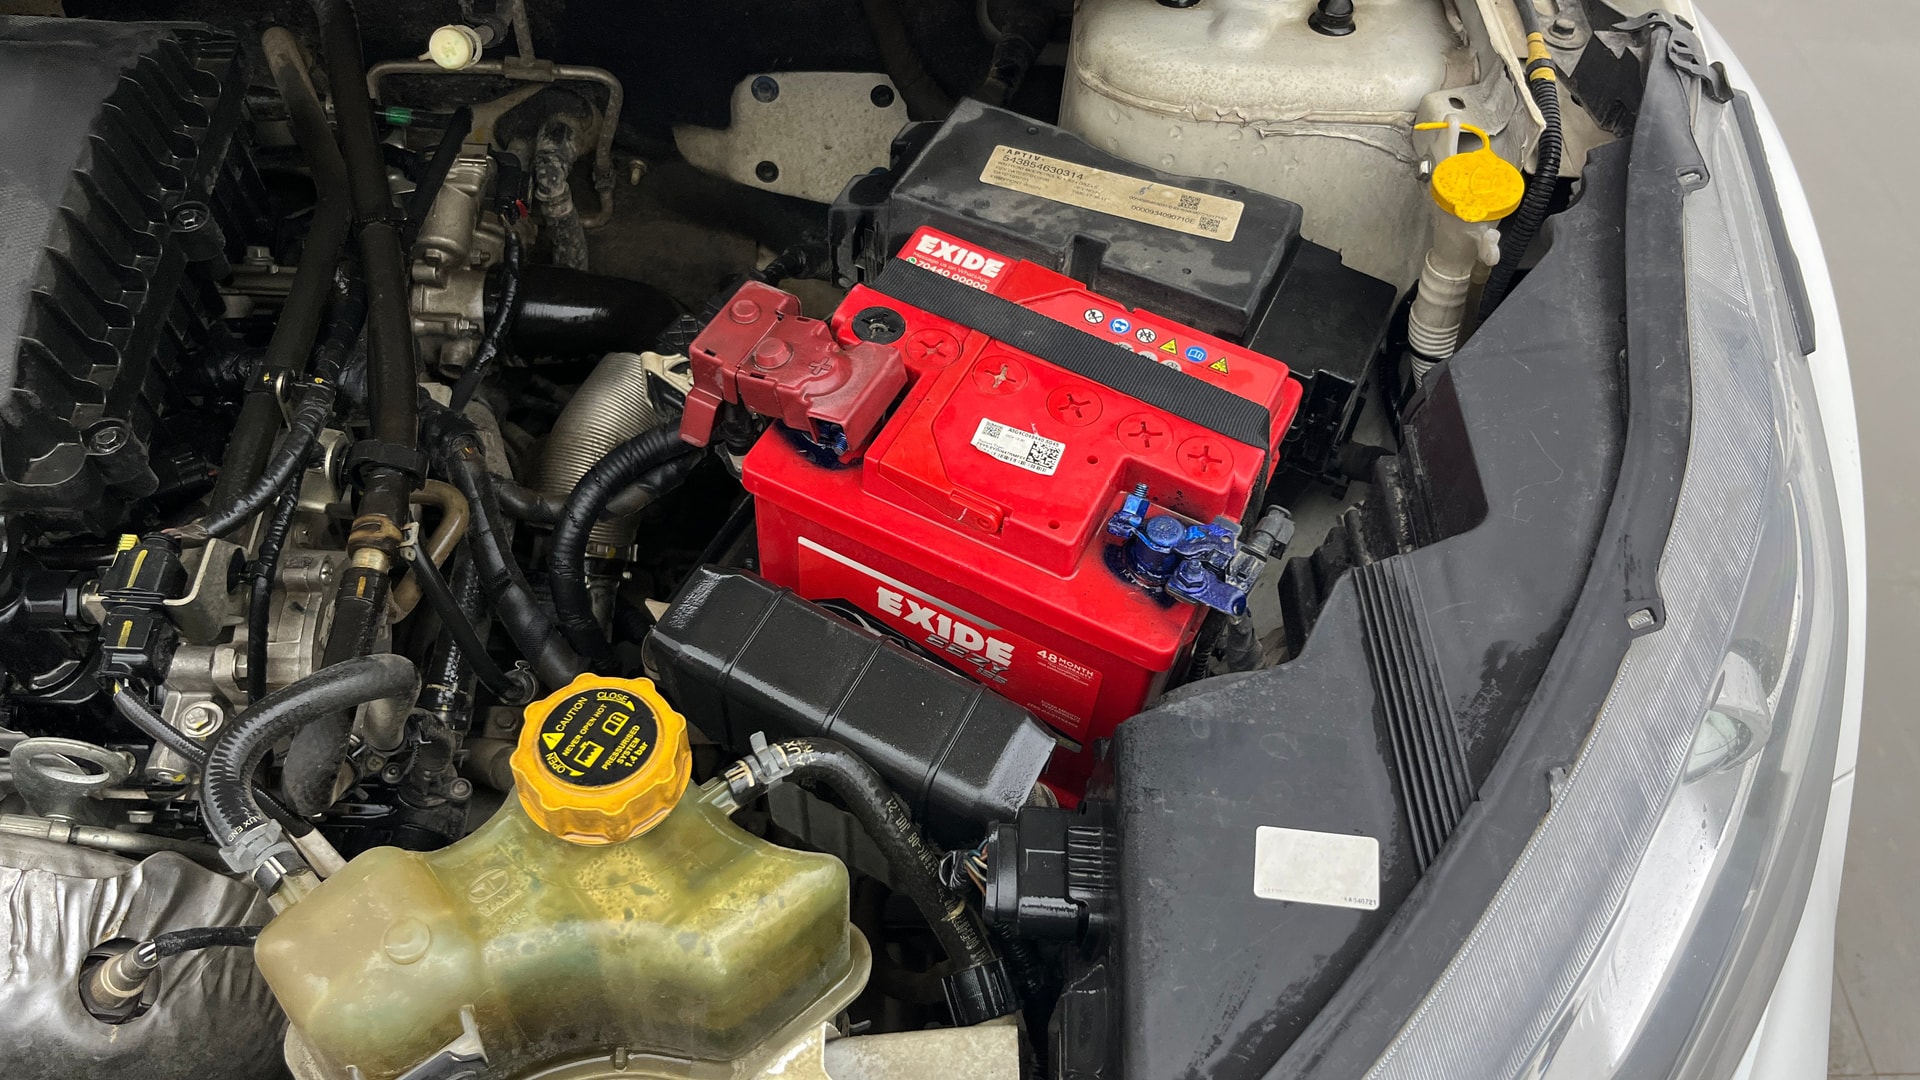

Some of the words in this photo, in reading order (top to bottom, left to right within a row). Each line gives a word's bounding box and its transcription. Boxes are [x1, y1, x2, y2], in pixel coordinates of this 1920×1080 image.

[1002, 155, 1084, 180] 543854630314
[1006, 149, 1041, 161] APTIV
[915, 234, 1005, 279] EXIDE
[916, 260, 950, 277] 70440
[951, 273, 988, 291] 00000
[876, 586, 1015, 667] EXIDE
[925, 634, 1011, 673] EEZY
[1037, 650, 1057, 663] 48
[1058, 657, 1094, 677] MONTH
[596, 691, 629, 703] CLOSE
[555, 696, 588, 732] CAUTION
[562, 734, 583, 757] NEVER
[580, 716, 597, 735] OPEN
[594, 703, 608, 718] HOT
[601, 725, 641, 771] PRESSURISED
[616, 737, 641, 765] SYSTEM
[624, 754, 638, 767] 1.4
[634, 741, 649, 757] bar
[545, 752, 566, 774] OPEN
[227, 825, 244, 842] END
[243, 814, 262, 828] AUX
